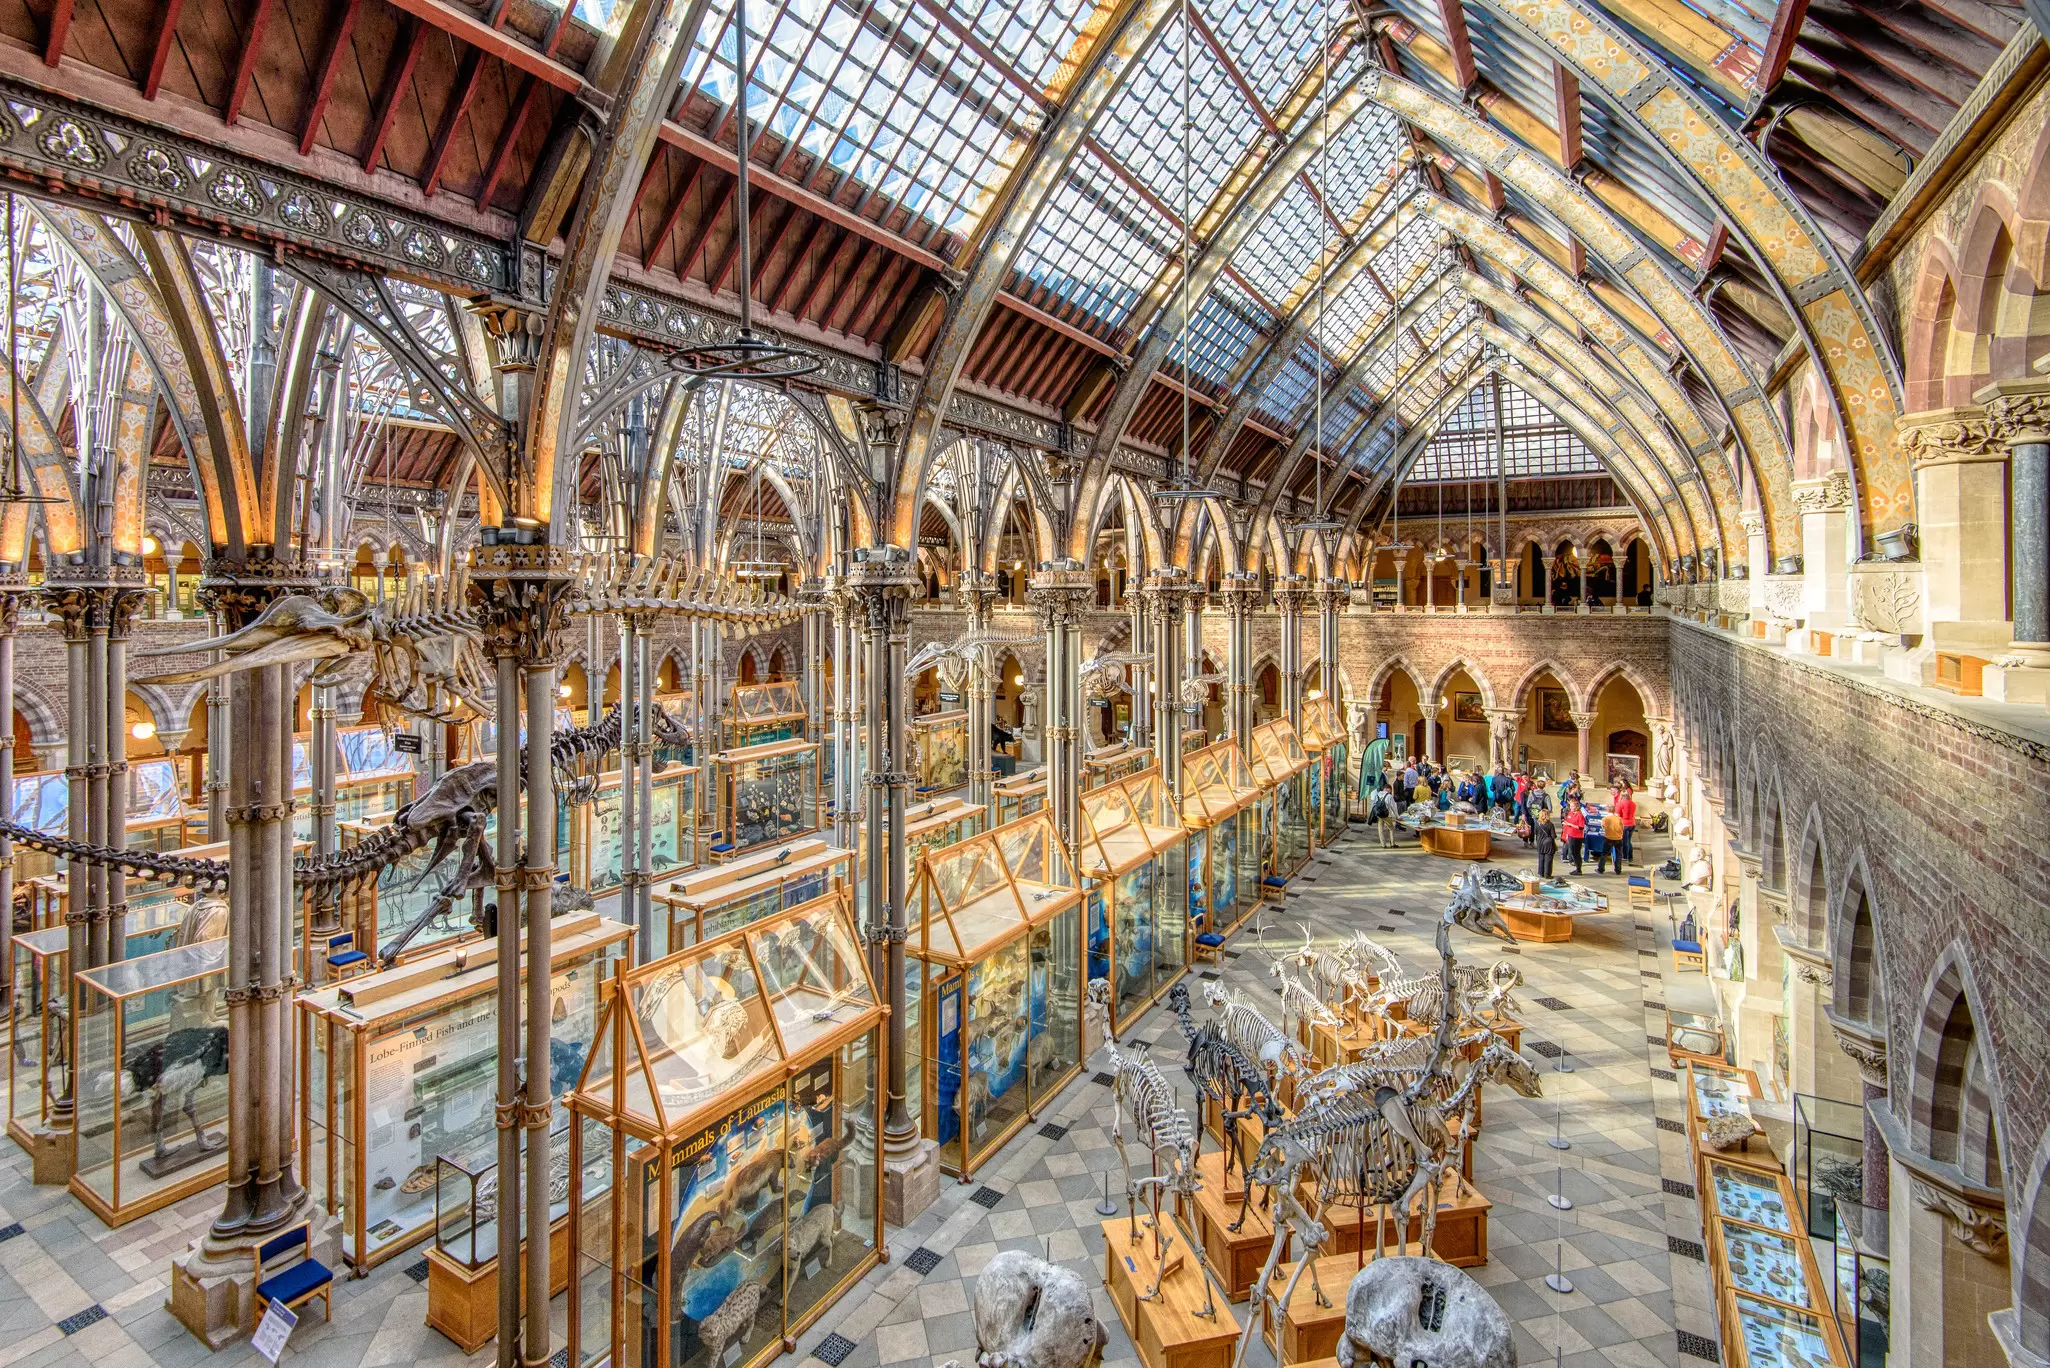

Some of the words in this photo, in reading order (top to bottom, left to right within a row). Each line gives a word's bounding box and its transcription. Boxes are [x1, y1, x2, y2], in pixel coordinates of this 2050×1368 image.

[370, 1030, 433, 1064] Lobe-Finned
[435, 1022, 455, 1039] Fish
[457, 1017, 474, 1032] and
[477, 1013, 490, 1023] the
[647, 1129, 716, 1181] Mmmals
[720, 1114, 734, 1136] of
[737, 1087, 785, 1127] Laurasia
